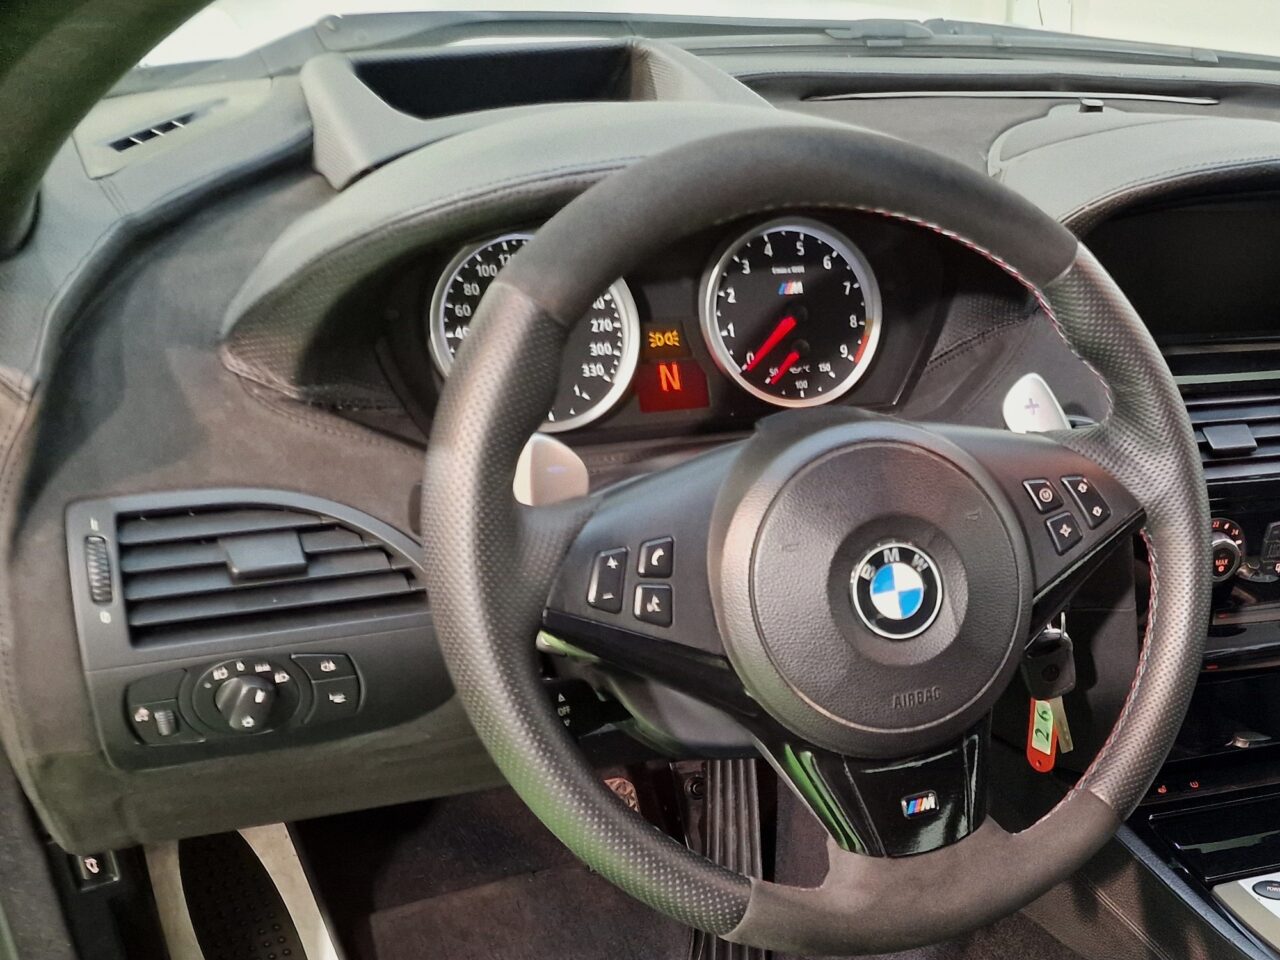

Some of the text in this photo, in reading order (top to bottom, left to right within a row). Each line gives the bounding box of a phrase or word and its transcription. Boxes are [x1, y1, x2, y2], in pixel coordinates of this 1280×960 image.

[764, 242, 773, 257] 4
[796, 241, 804, 256] 5
[741, 259, 750, 275] 3
[823, 255, 832, 270] 6
[475, 264, 497, 277] 100
[463, 282, 480, 296] 80
[726, 286, 736, 304] 2
[842, 281, 850, 296] 7
[454, 303, 472, 317] 60
[590, 318, 613, 333] 270
[849, 314, 858, 328] 8
[727, 322, 735, 338] 1
[589, 341, 612, 357] 300
[840, 344, 848, 359] 9
[581, 362, 604, 378] 330
[659, 362, 681, 392] N
[860, 547, 928, 582] BMW
[891, 685, 941, 710] AIRBAG
[1034, 709, 1050, 743] 26
